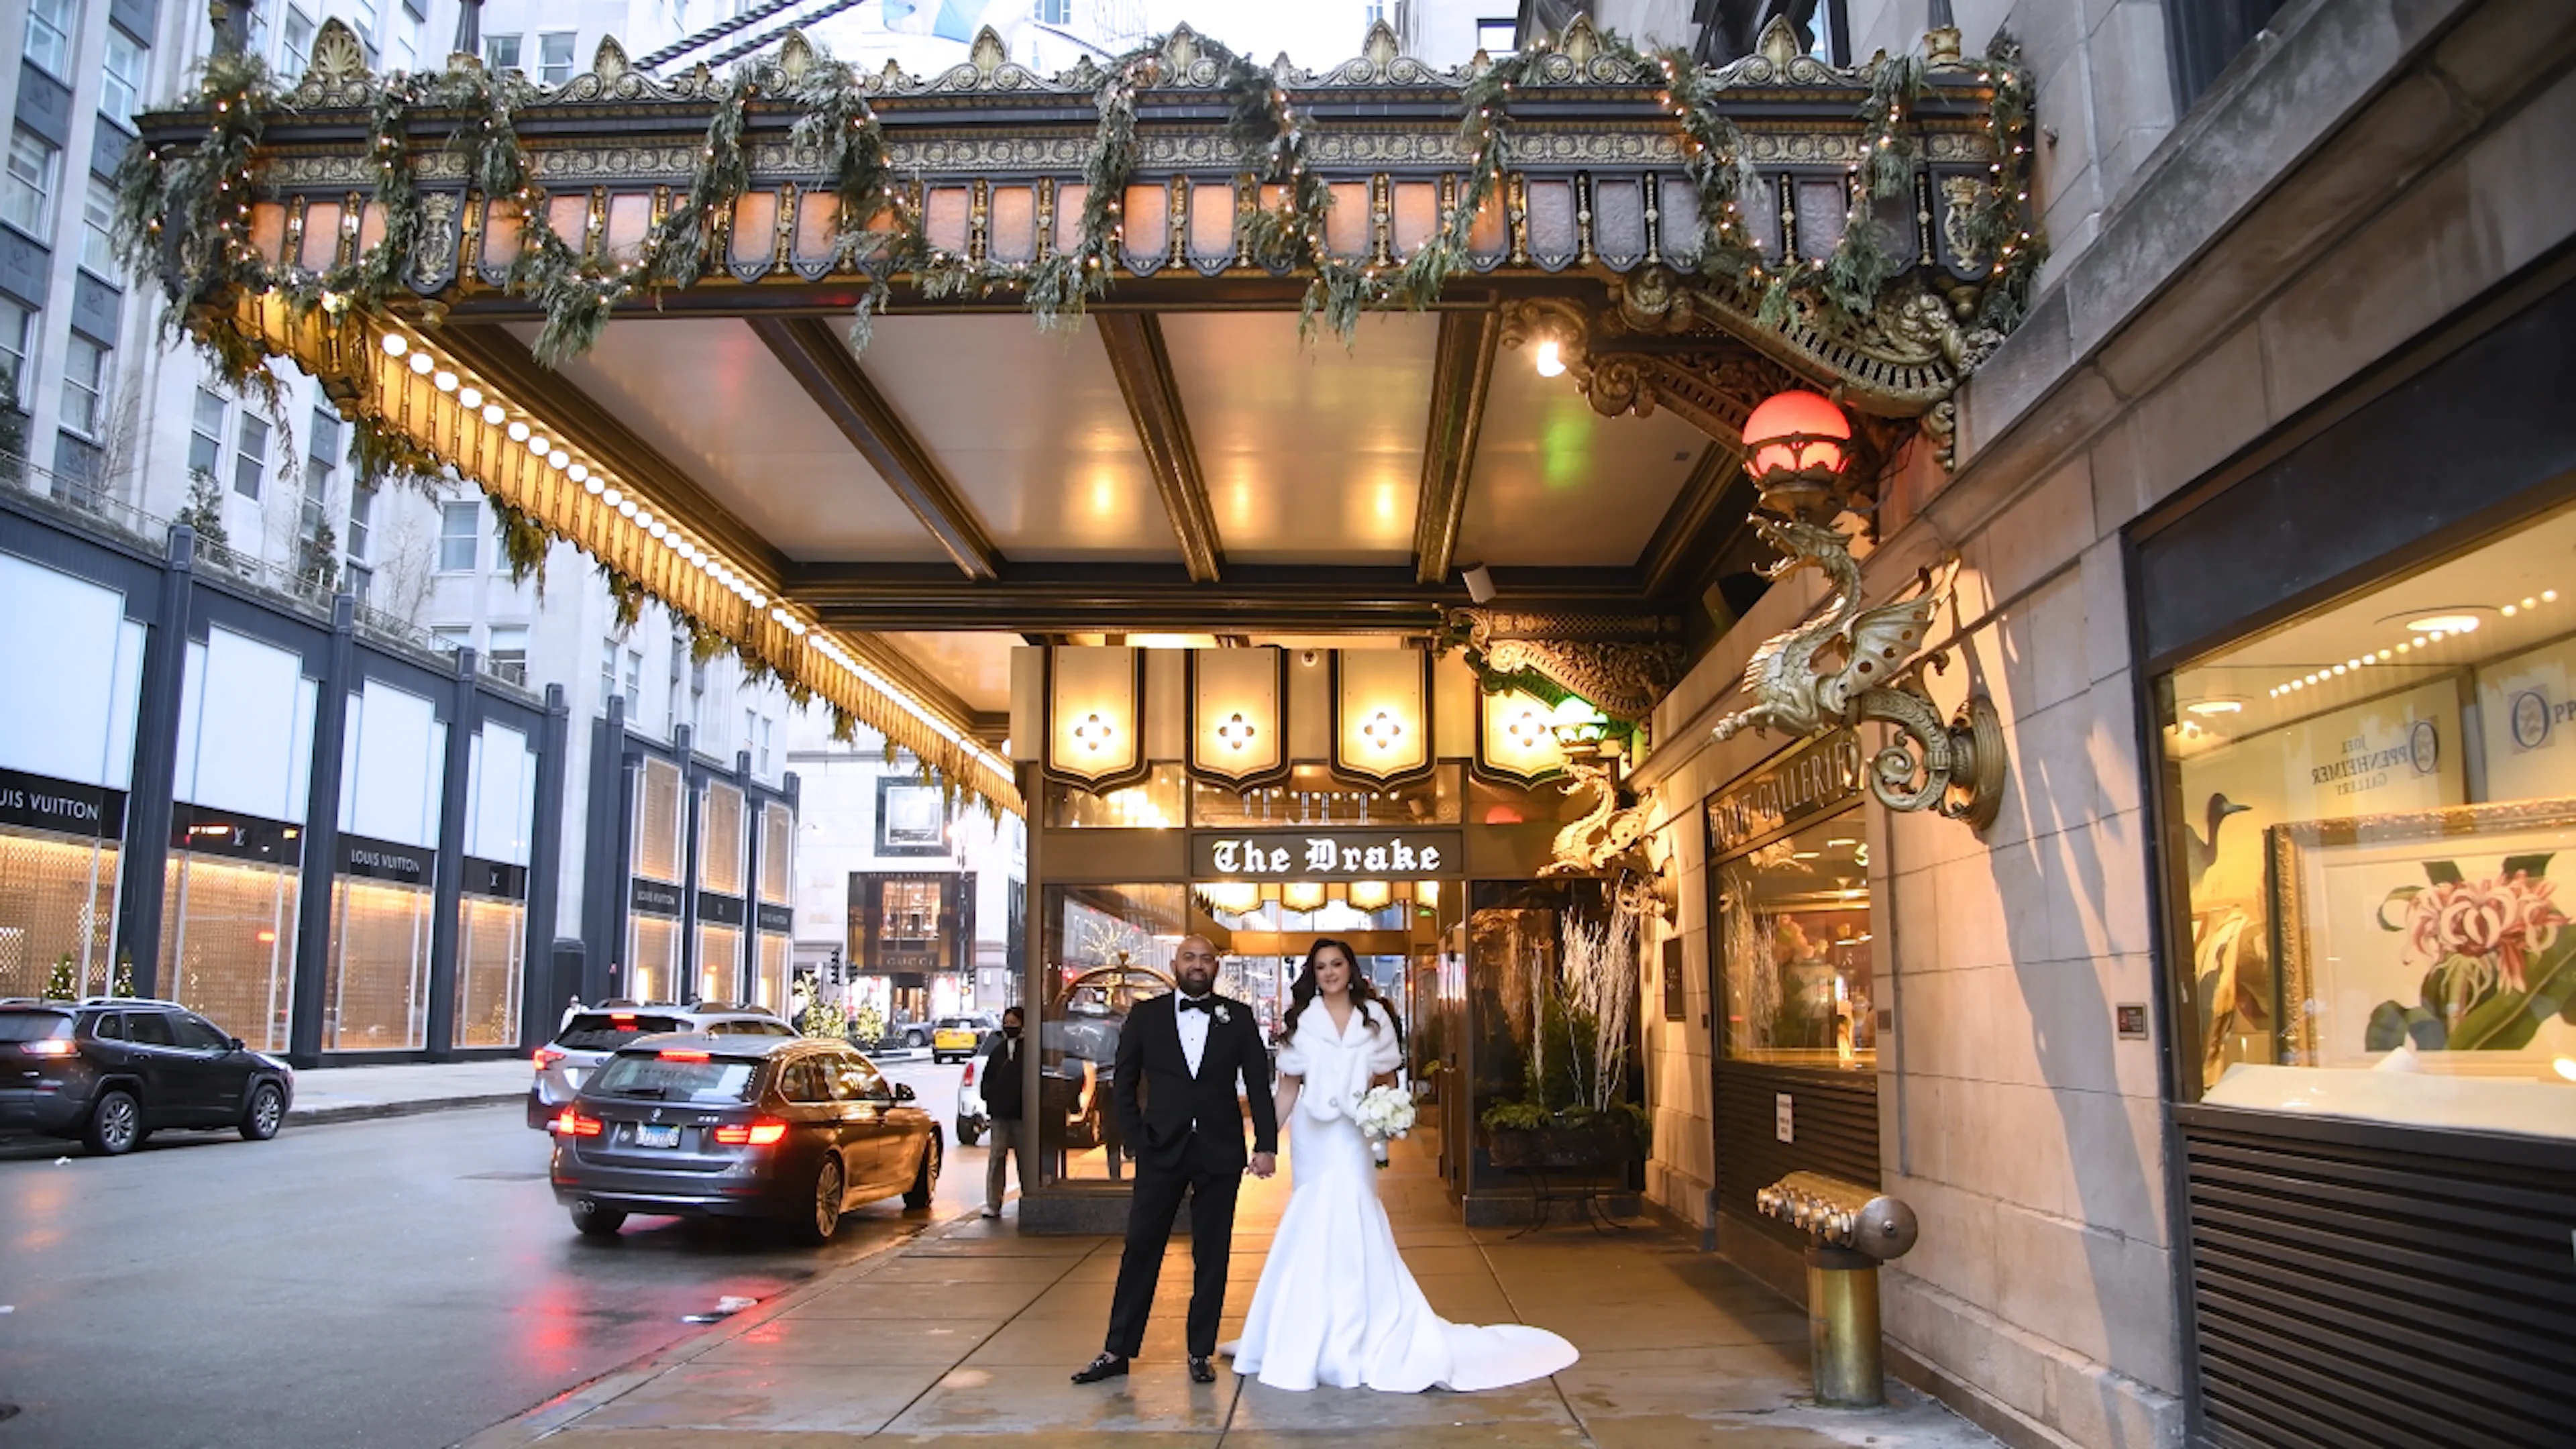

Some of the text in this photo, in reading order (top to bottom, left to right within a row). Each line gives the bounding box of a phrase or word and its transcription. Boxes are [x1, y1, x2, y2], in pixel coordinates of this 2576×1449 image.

[1758, 741, 1853, 821] GALLERIE
[30, 792, 100, 821] VUITTON
[351, 848, 420, 873] LOUIS VUITTON
[1212, 837, 1441, 873] The Drake
[886, 957, 933, 967] GUCCI
